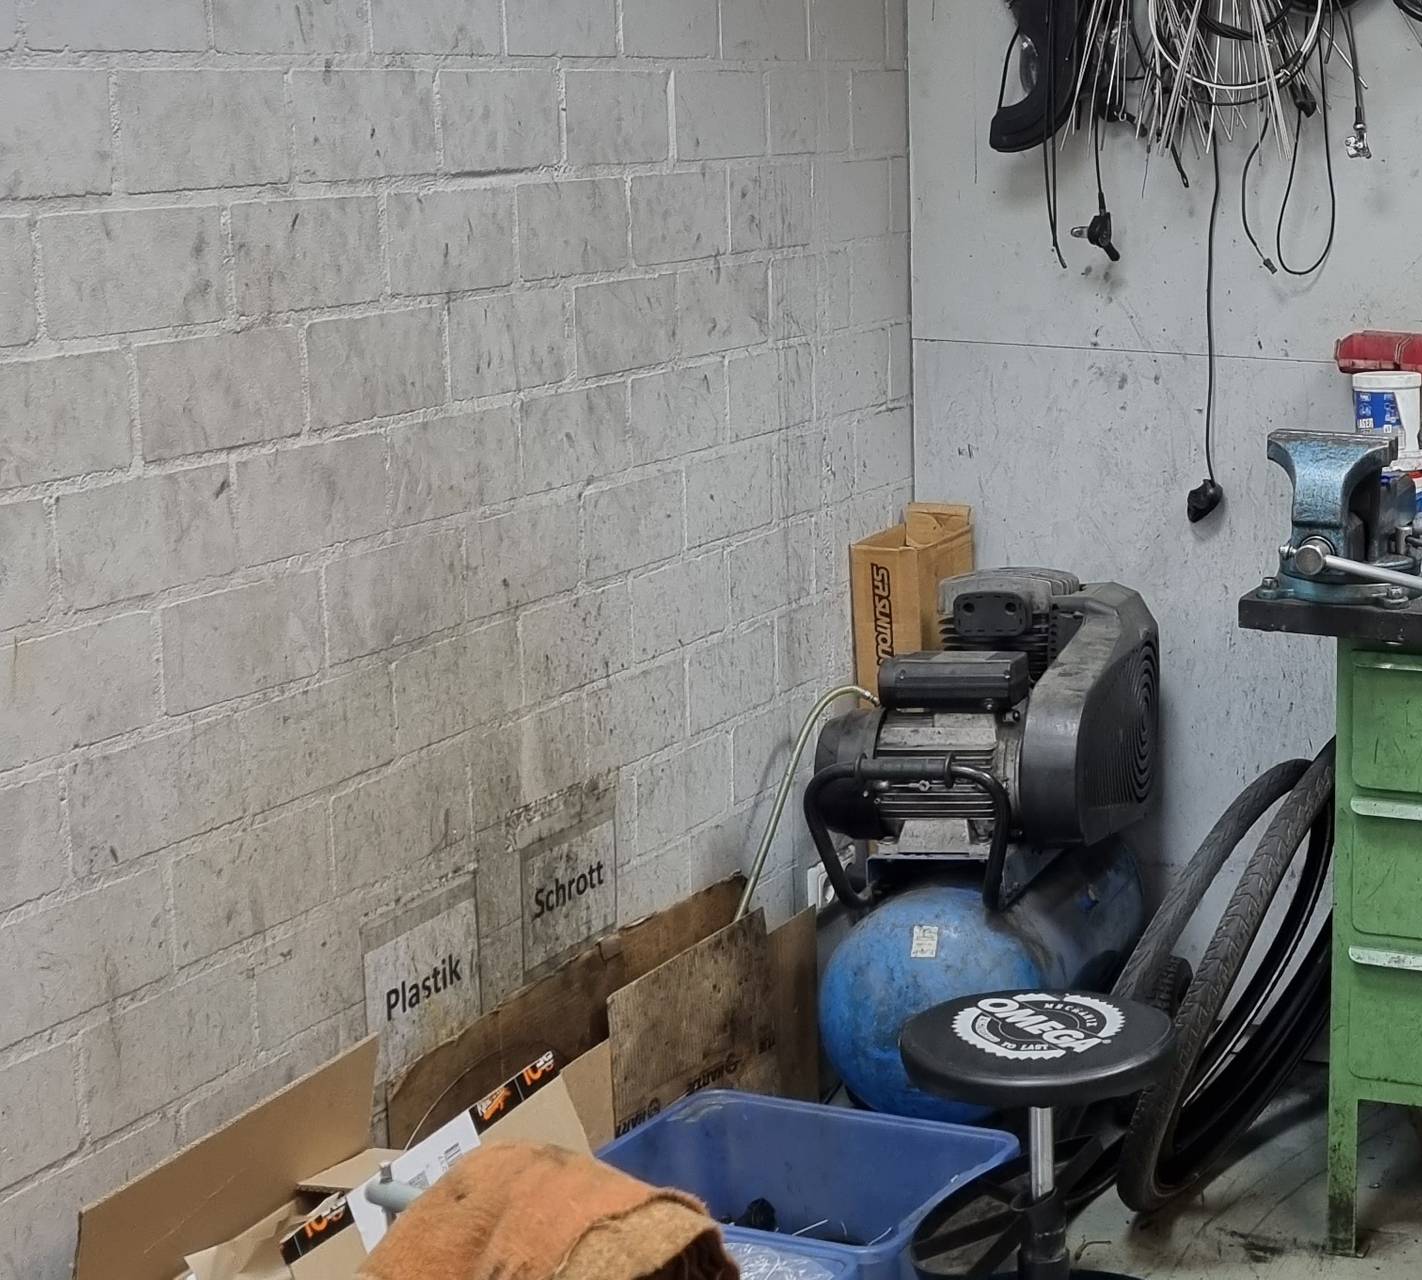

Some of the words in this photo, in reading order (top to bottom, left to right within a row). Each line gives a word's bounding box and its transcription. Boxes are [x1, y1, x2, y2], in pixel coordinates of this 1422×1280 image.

[873, 597, 895, 665] SUNTOU
[532, 861, 604, 920] Schrott
[386, 954, 462, 1021] Plastik
[977, 998, 1101, 1053] OMEGA
[1020, 1043, 1049, 1051] LAST
